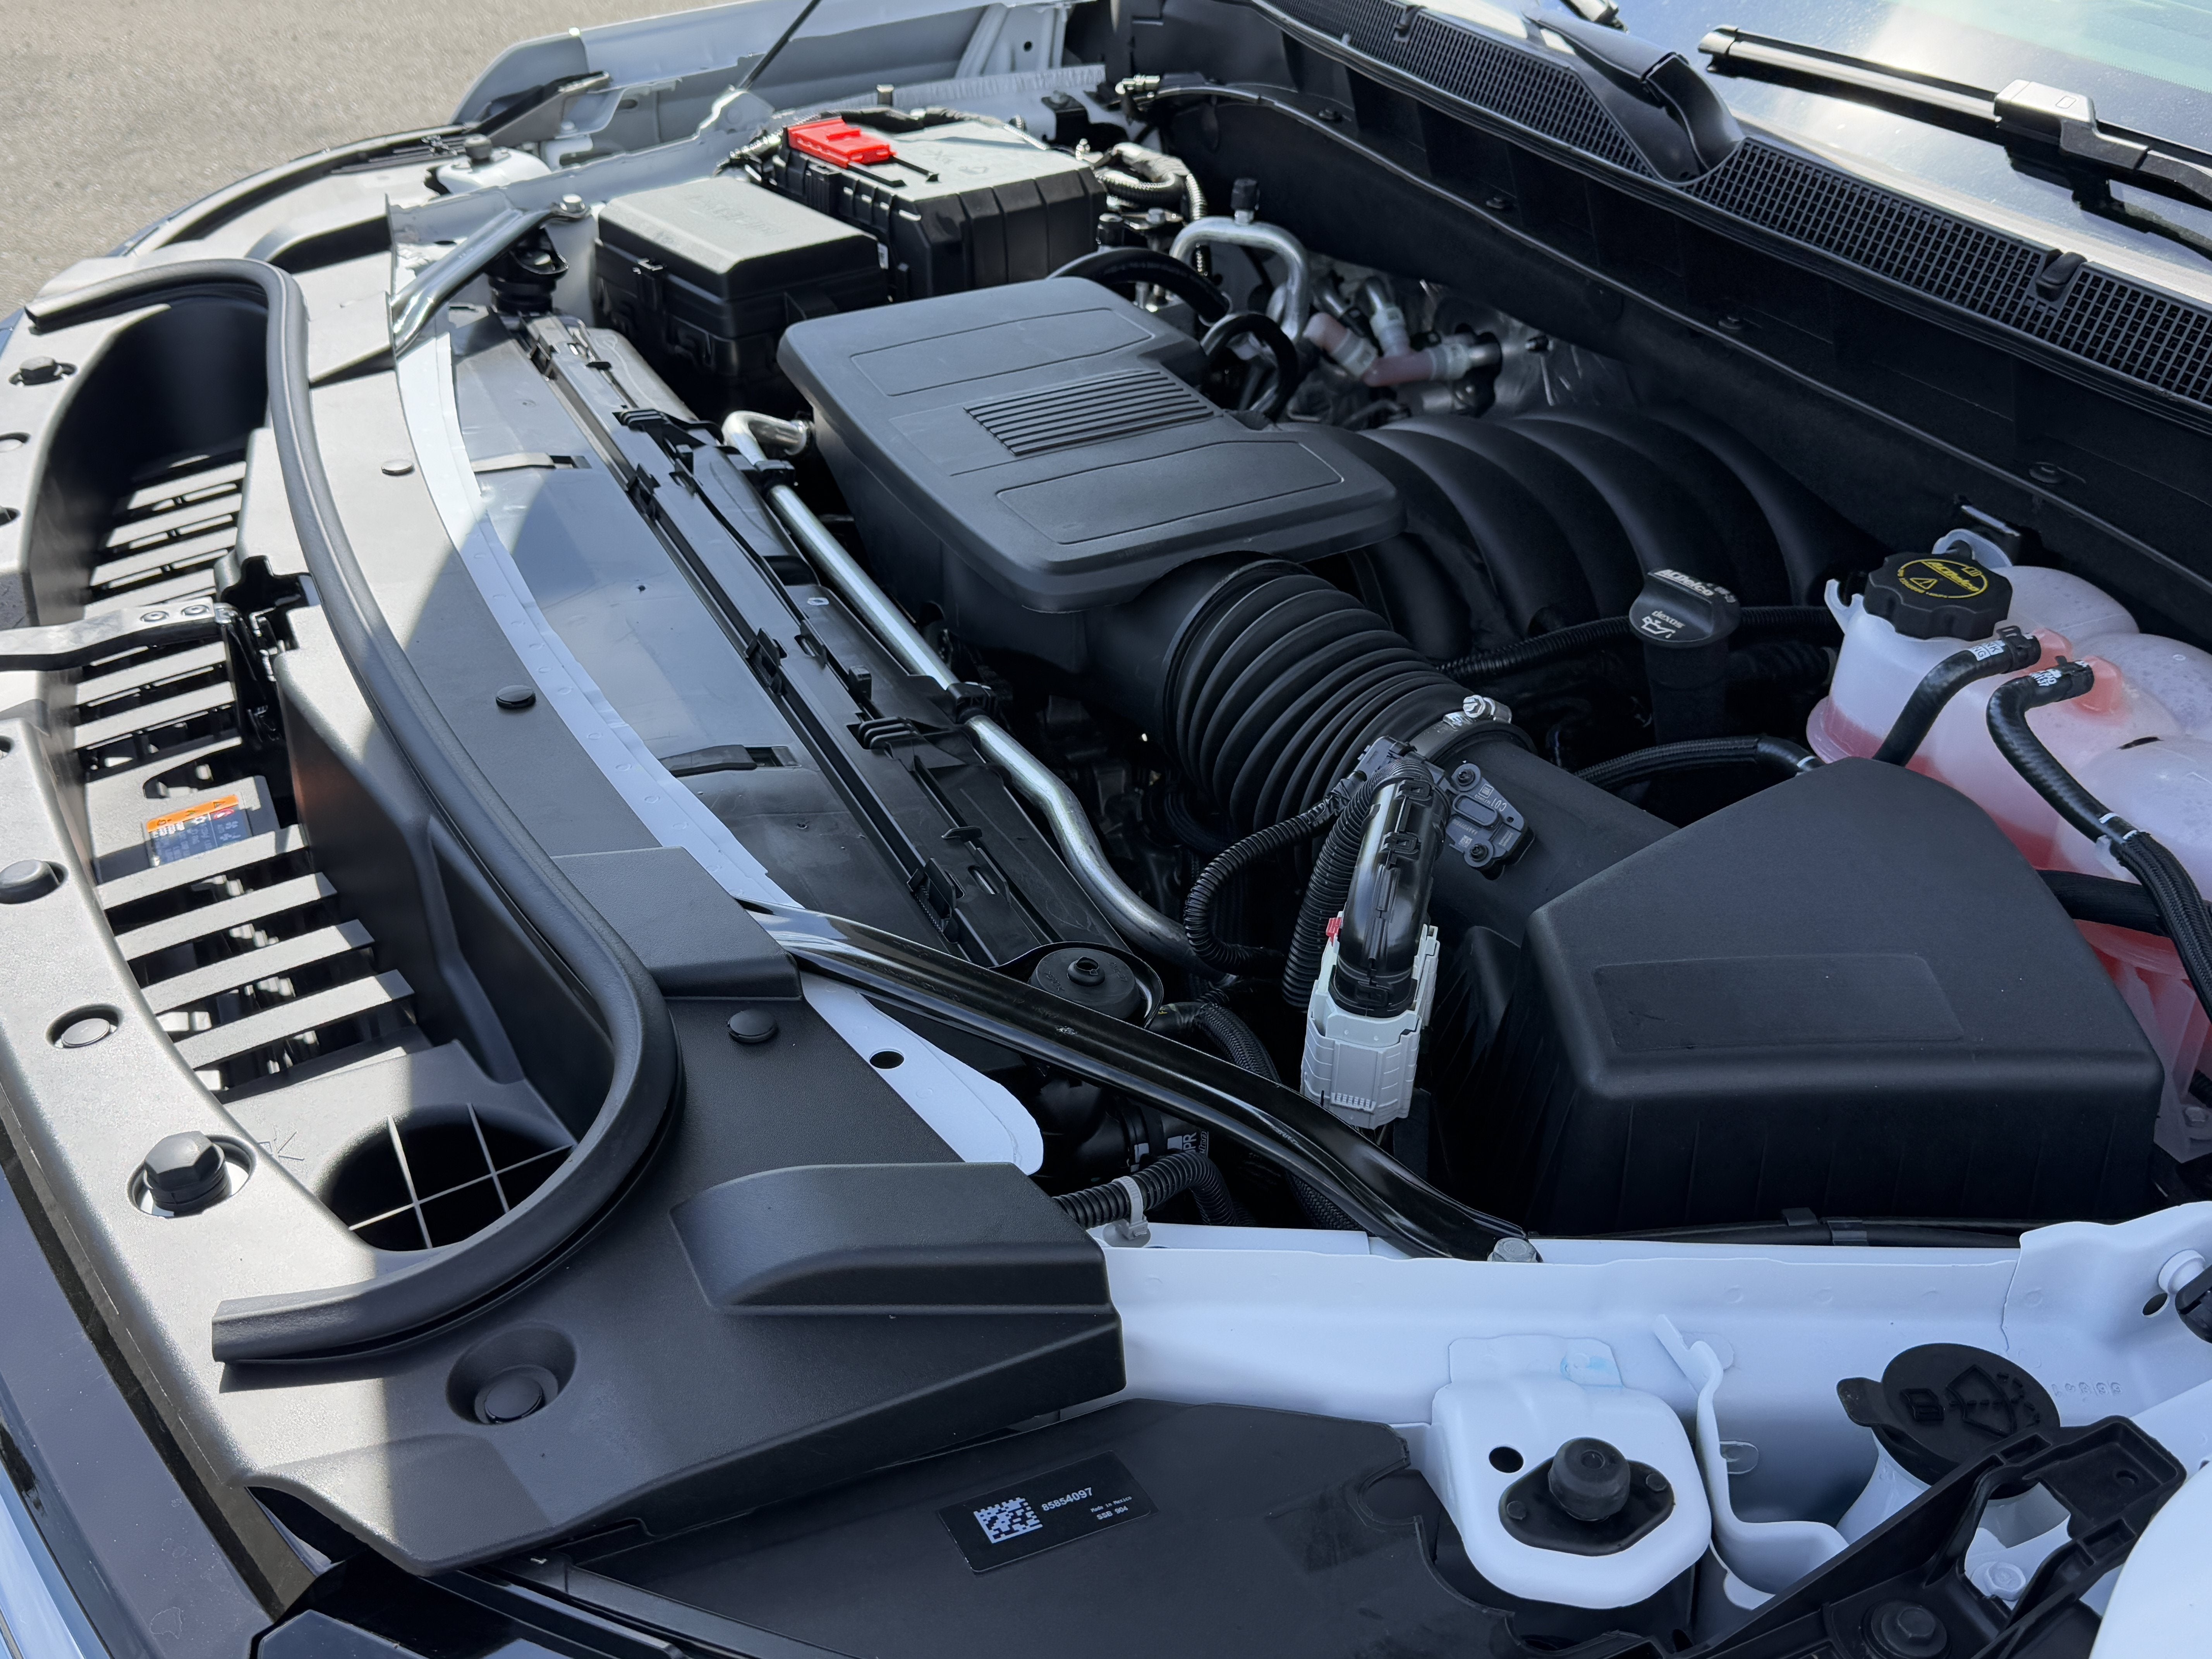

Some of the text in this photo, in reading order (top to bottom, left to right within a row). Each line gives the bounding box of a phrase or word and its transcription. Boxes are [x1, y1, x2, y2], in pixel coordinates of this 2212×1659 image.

[1654, 569, 1714, 596] ACDelco
[1927, 561, 1980, 592] ACDelco
[1651, 610, 1685, 629] dexos
[1490, 797, 1507, 812] C01
[1042, 1487, 1093, 1512] 85854097
[1090, 1504, 1104, 1513] Made
[1113, 1496, 1133, 1506] Mexico
[1096, 1509, 1113, 1520] SSB
